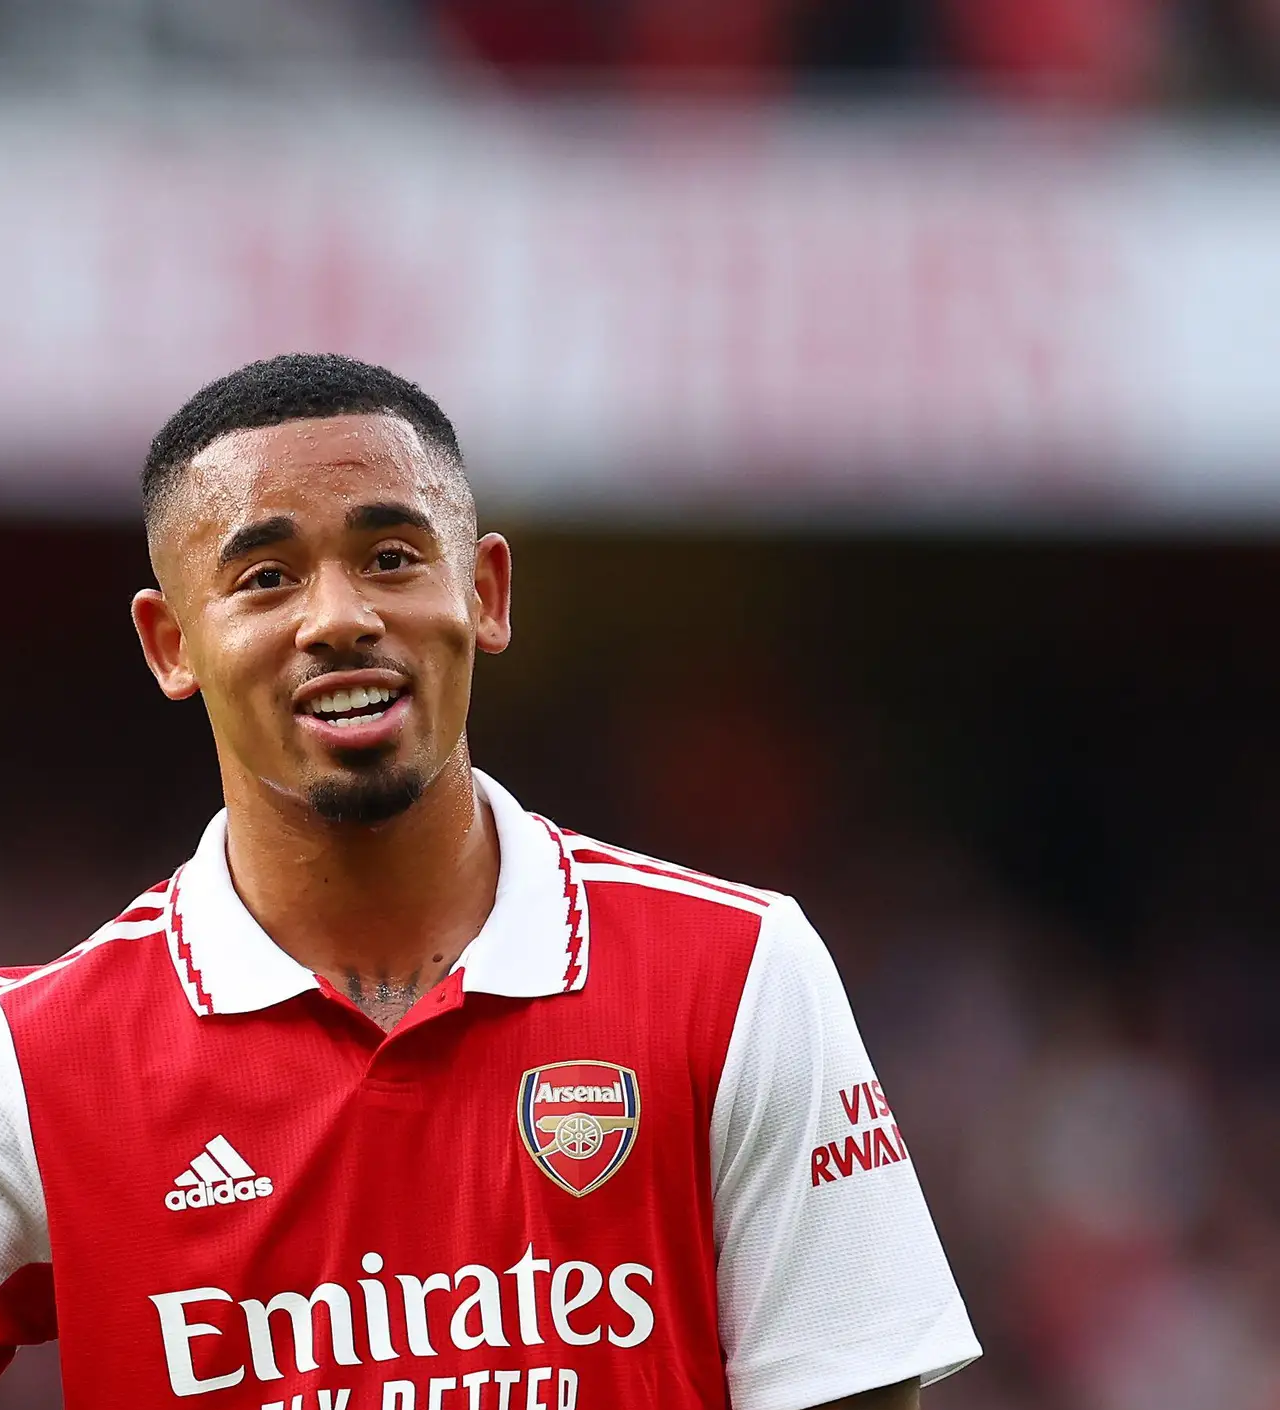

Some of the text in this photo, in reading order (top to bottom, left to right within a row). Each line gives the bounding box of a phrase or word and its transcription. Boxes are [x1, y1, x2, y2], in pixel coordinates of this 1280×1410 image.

[534, 1081, 623, 1104] Arsenal
[164, 1176, 274, 1211] adidas
[148, 1242, 655, 1397] Emirates
